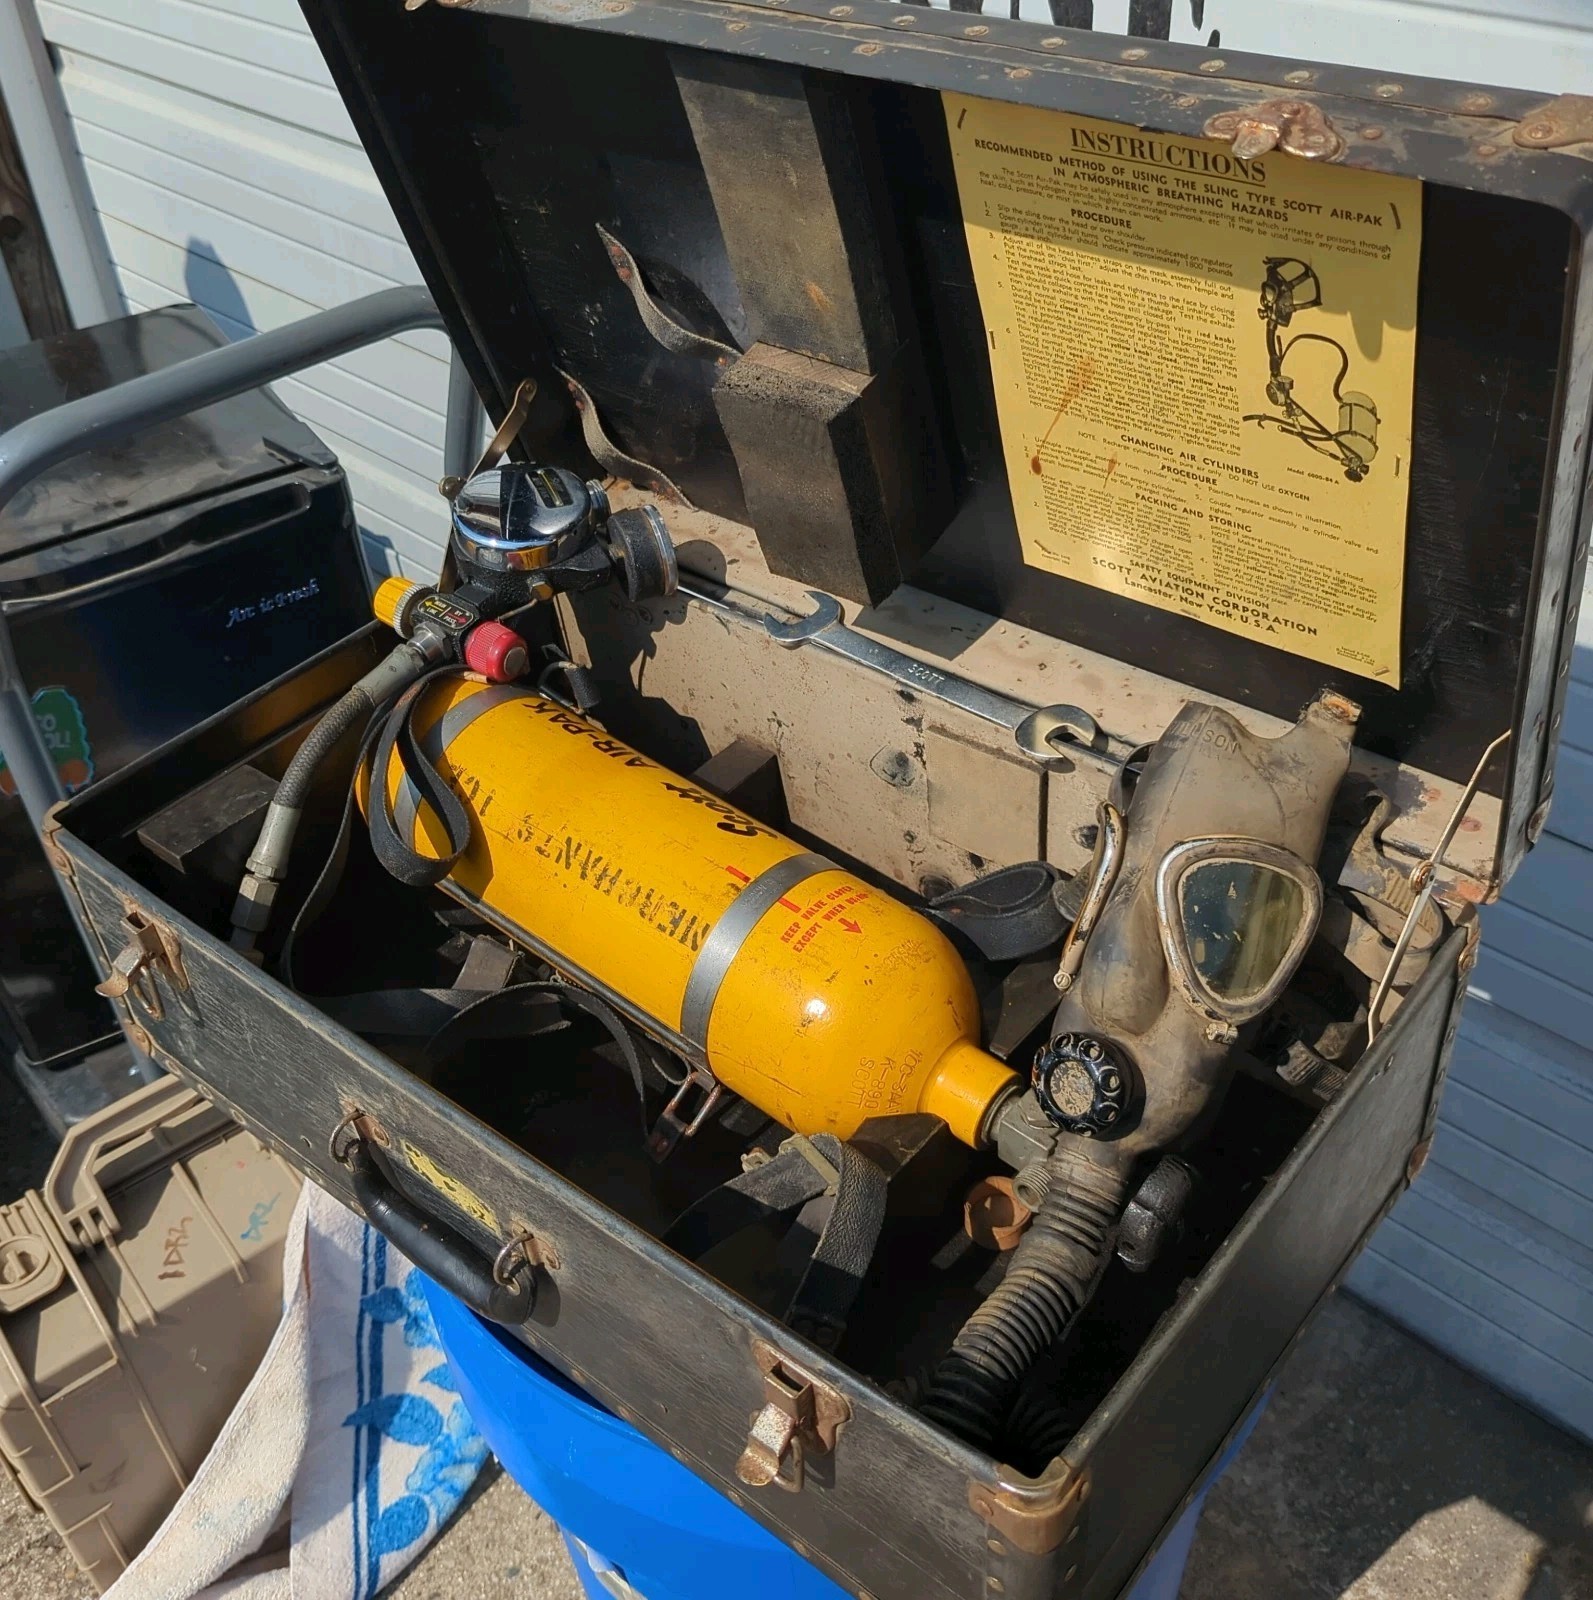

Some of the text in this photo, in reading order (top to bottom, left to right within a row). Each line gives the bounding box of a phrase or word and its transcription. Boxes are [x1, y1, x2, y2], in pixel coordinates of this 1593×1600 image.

[1070, 127, 1265, 182] INSTRUCTIONS
[974, 138, 1382, 226] RECOMMENDED METHOD OF USING THE SLING TYPE SCOTT AIR-PAK
[1052, 166, 1288, 222] IN ATMOSPHERIC BREATHING HAZARDS
[978, 170, 990, 178] the
[1009, 177, 1025, 185] such
[1035, 181, 1067, 194] hydrogen
[1097, 194, 1120, 206] highly
[1121, 201, 1167, 215] concentrated
[1228, 220, 1235, 228] It
[1238, 224, 1254, 234] may
[1257, 227, 1267, 236] be
[1270, 231, 1288, 240] used
[1291, 236, 1314, 245] under
[1318, 241, 1332, 250] any
[1335, 244, 1378, 258] conditions
[1381, 251, 1390, 260] of
[996, 203, 1010, 212] Slip
[1011, 207, 1023, 215] the
[1024, 209, 1041, 220] sling
[1042, 214, 1056, 222] over
[1058, 217, 1069, 225] the
[1071, 219, 1088, 229] head
[1099, 226, 1114, 235] over
[1001, 166, 1014, 176] The
[1016, 170, 1033, 180] Scott
[1035, 174, 1061, 186] Air-Pak
[1062, 181, 1077, 190] may
[1078, 182, 1088, 191] be
[1112, 191, 1129, 200] used
[1140, 197, 1153, 206] any
[1155, 200, 1197, 214] atmosphere
[1198, 208, 1236, 222] excepting
[1237, 215, 1253, 224] that
[1255, 220, 1279, 230] which
[1281, 226, 1312, 237] irritates
[1326, 234, 1356, 247] poisons
[1359, 240, 1391, 254] through
[1070, 207, 1131, 229] PROCEDURE
[1002, 235, 1023, 245] Adjust
[1045, 244, 1056, 252] the
[1057, 247, 1074, 256] head
[1075, 251, 1100, 262] harness
[1102, 258, 1122, 268] straps
[1135, 265, 1147, 273] the
[1149, 269, 1167, 278] mask
[1170, 274, 1201, 286] assembly
[1204, 279, 1216, 289] full
[1003, 241, 1014, 250] Put
[1028, 248, 1046, 257] mask
[1098, 264, 1119, 274] adjust
[1120, 268, 1132, 277] the
[1134, 272, 1149, 281] chin
[1175, 281, 1192, 290] then
[1194, 285, 1218, 296] temple
[1220, 292, 1234, 300] and
[1120, 434, 1258, 479] CHANGING AIR CYLINDERS
[1132, 447, 1160, 459] cylinders
[1161, 455, 1177, 464] with
[1228, 472, 1239, 481] DO
[1242, 476, 1258, 486] NOT
[1261, 482, 1275, 492] USE
[1277, 487, 1309, 501] OXYGEN
[1160, 463, 1217, 486] PROCEDURE
[1286, 466, 1304, 475] Model
[1134, 492, 1252, 532] PACKING AND STORING
[1207, 485, 1234, 498] Position
[1235, 494, 1260, 505] harness
[1271, 505, 1293, 515] shown
[1092, 556, 1131, 575] SCOTT
[1139, 572, 1204, 600] AVIATION
[1211, 596, 1317, 636] CORPORATION
[1124, 576, 1177, 600] Lancaster,
[1178, 594, 1203, 608] New
[1206, 603, 1236, 620] York,
[1129, 559, 1269, 609] SAFETY EQUIPMENT DIVISION
[907, 664, 945, 684] SCOTT
[522, 702, 778, 840] Scott AIR-PAK
[780, 922, 802, 944] KEEP
[800, 899, 830, 921] VALVE
[792, 922, 824, 954] EXCEPT
[822, 904, 847, 923] WHEN
